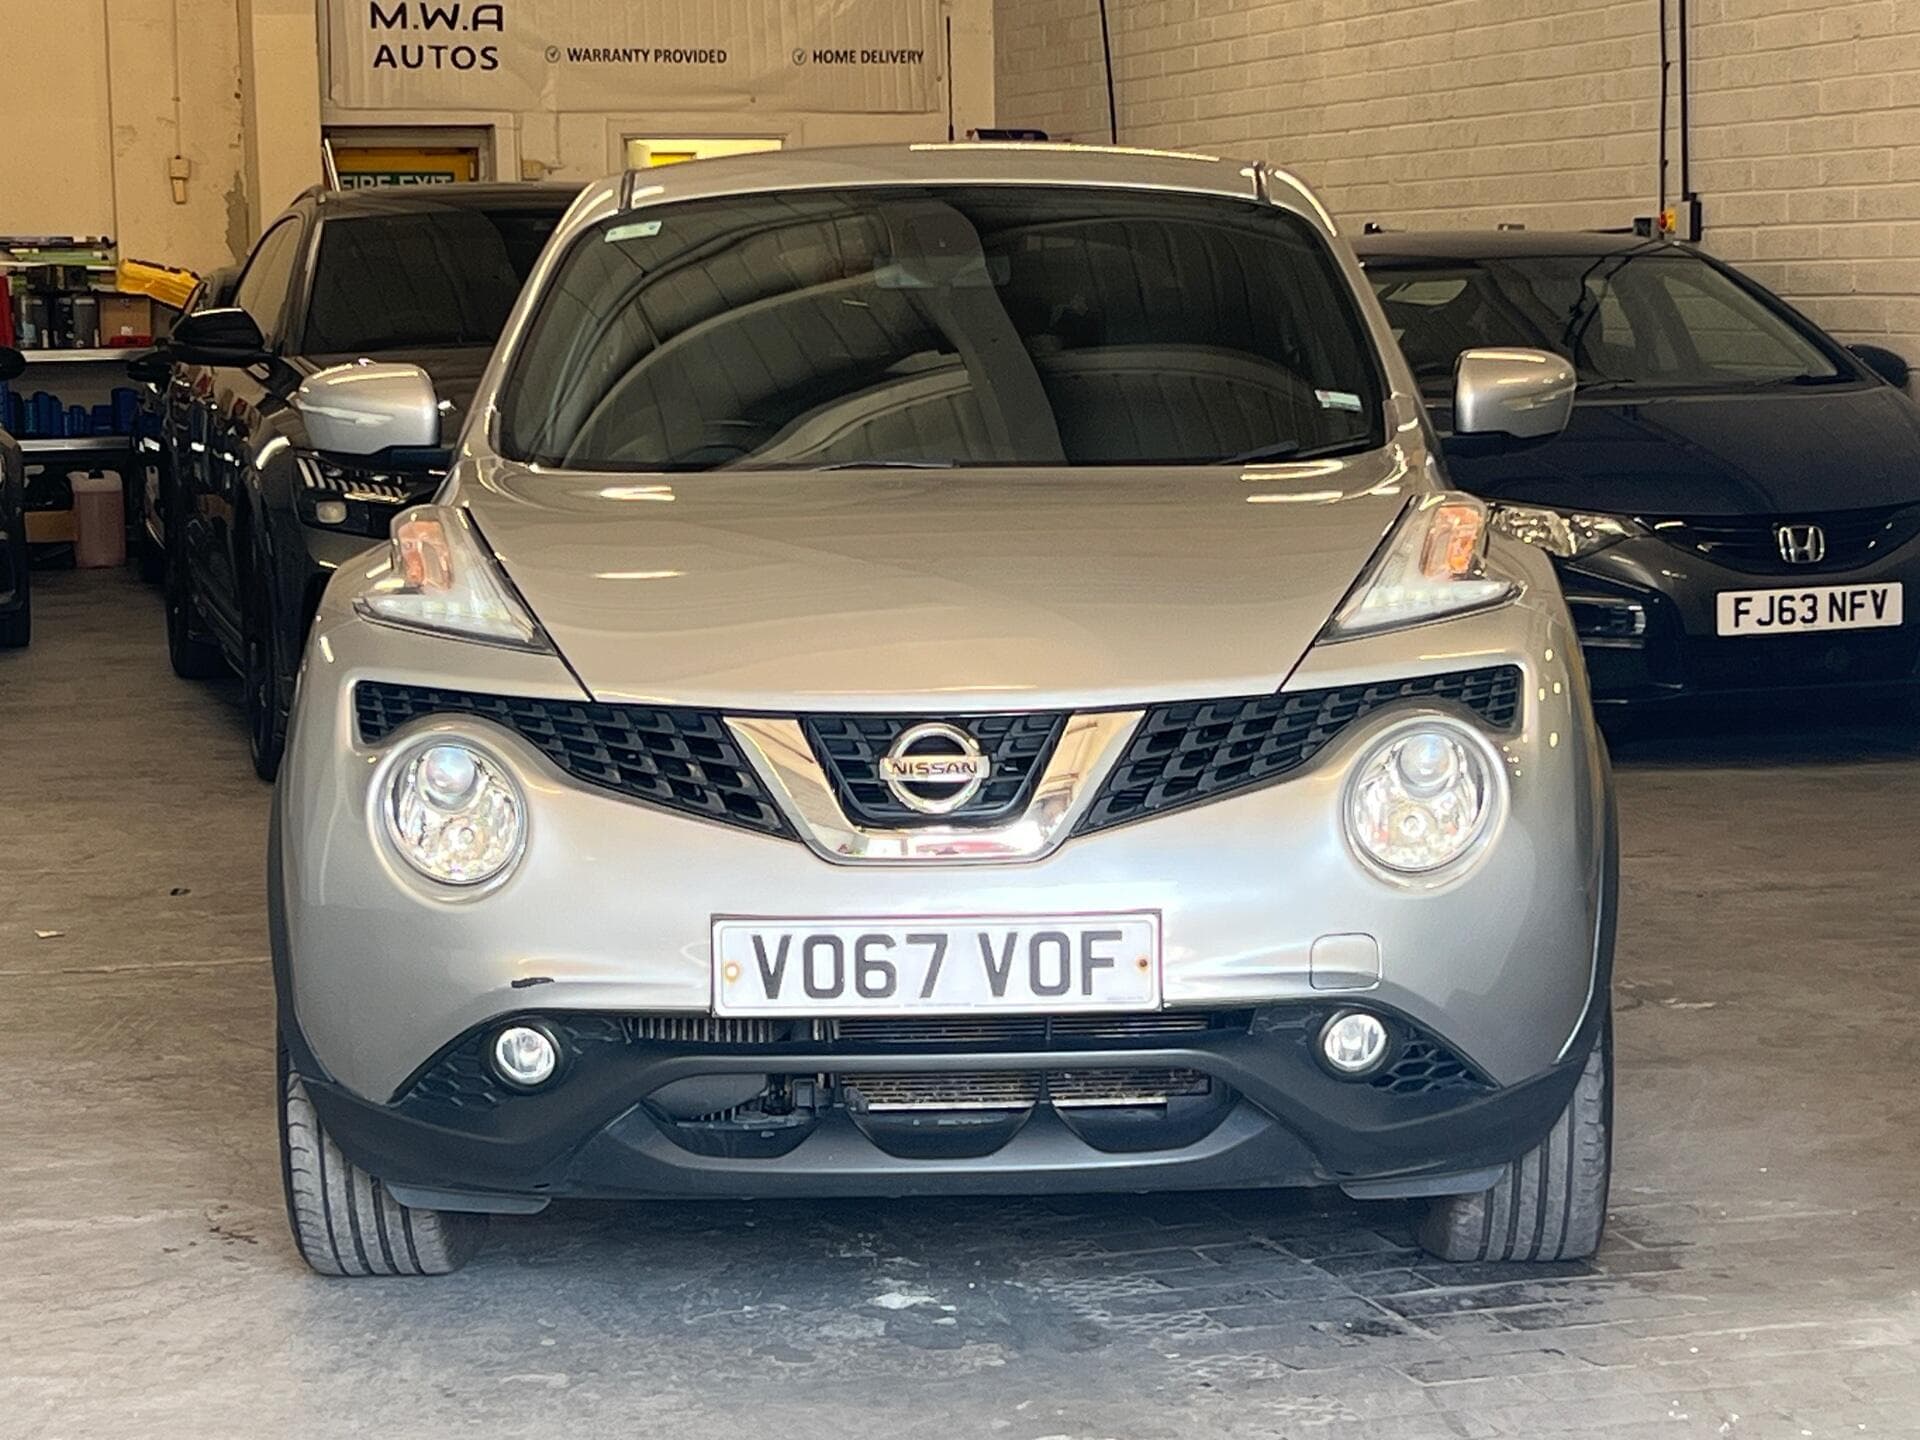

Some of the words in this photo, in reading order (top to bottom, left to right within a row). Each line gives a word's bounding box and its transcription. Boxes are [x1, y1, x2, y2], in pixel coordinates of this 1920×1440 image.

[370, 1, 504, 32] M.W.A
[373, 44, 499, 71] AUTOS
[567, 48, 650, 63] WARRANTY
[653, 48, 728, 64] PROVIDED
[812, 49, 857, 64] HOME
[860, 49, 924, 65] DELIVERY
[1734, 593, 1819, 628] FJ63
[1829, 588, 1888, 623] NFV
[892, 761, 978, 777] NISSAN
[751, 932, 949, 1000] VO67
[977, 930, 1123, 998] VOF
